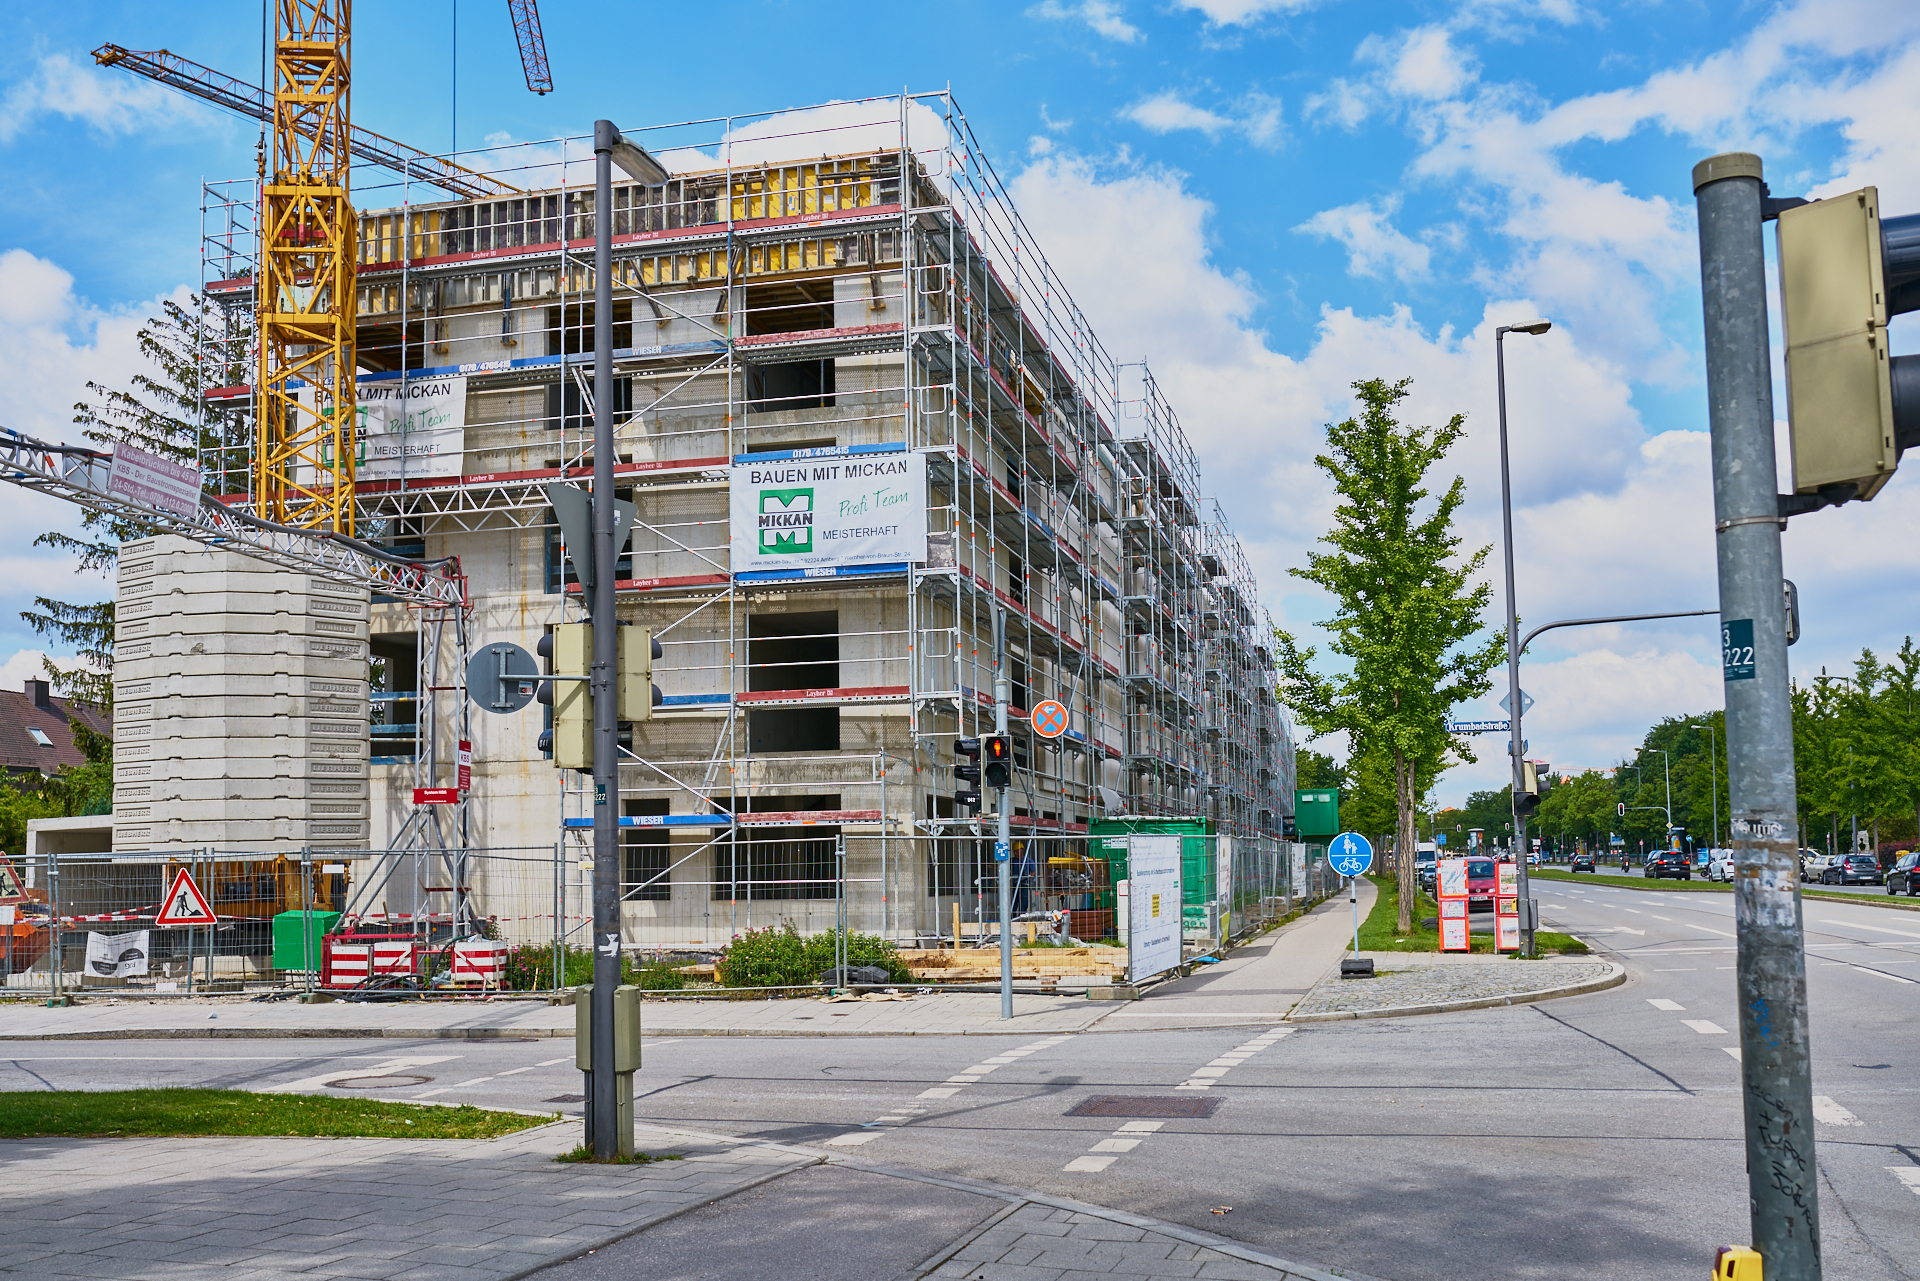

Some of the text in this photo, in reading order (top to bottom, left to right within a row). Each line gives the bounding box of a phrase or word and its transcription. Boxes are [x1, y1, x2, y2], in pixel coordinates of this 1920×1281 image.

[632, 346, 661, 355] WIESER
[366, 388, 393, 400] MIT
[395, 383, 450, 400] MICKAN
[418, 408, 451, 427] Team
[121, 448, 170, 473] Kabelbrücken
[170, 465, 180, 478] bis
[181, 470, 189, 481] 45
[636, 462, 655, 470] Layher
[751, 460, 908, 484] BAUEN MIT MICKAN
[116, 463, 130, 474] KBS
[134, 472, 146, 480] Der
[146, 474, 196, 500] Baustromspezialist
[839, 487, 908, 518] Profi Team
[758, 513, 813, 528] MICKAN
[822, 526, 898, 540] MEISTERHAFT
[804, 568, 836, 577] WIESER
[633, 579, 652, 587] Layher
[1723, 629, 1730, 647] 3
[1724, 646, 1754, 667] 222
[806, 690, 826, 698] Layher
[1448, 722, 1508, 731] Krumbadstraße
[460, 754, 470, 763] KBS
[632, 816, 664, 825] WIESER
